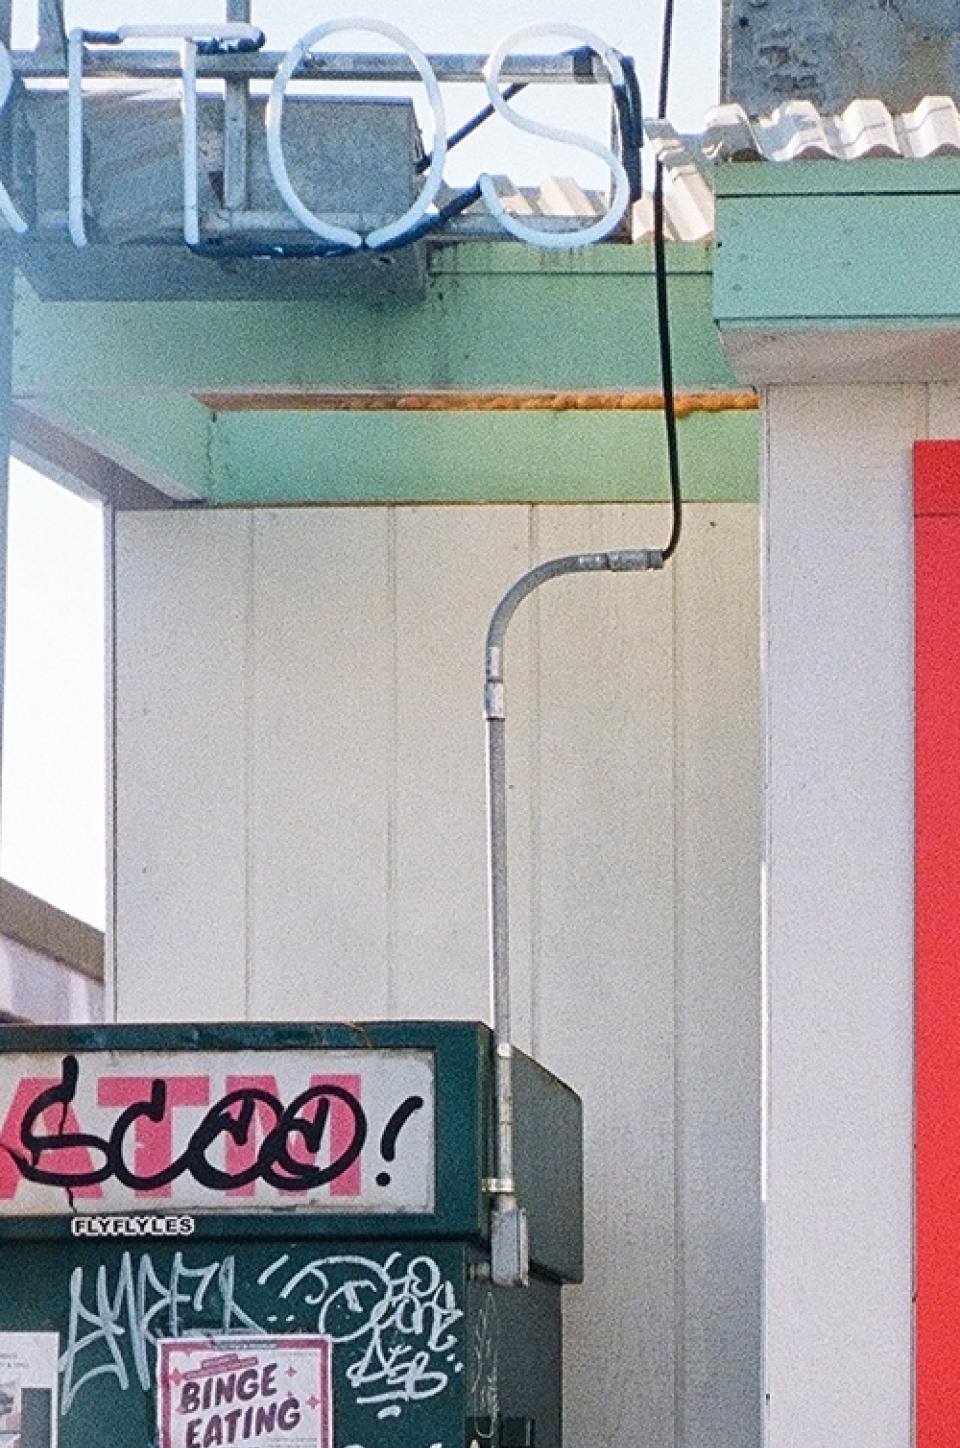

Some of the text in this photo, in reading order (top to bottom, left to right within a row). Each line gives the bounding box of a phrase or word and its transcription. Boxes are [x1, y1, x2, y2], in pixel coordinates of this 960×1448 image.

[0, 18, 630, 250] ITOS
[73, 1217, 194, 1235] FLYFLYLES
[180, 1362, 278, 1414] BINGE
